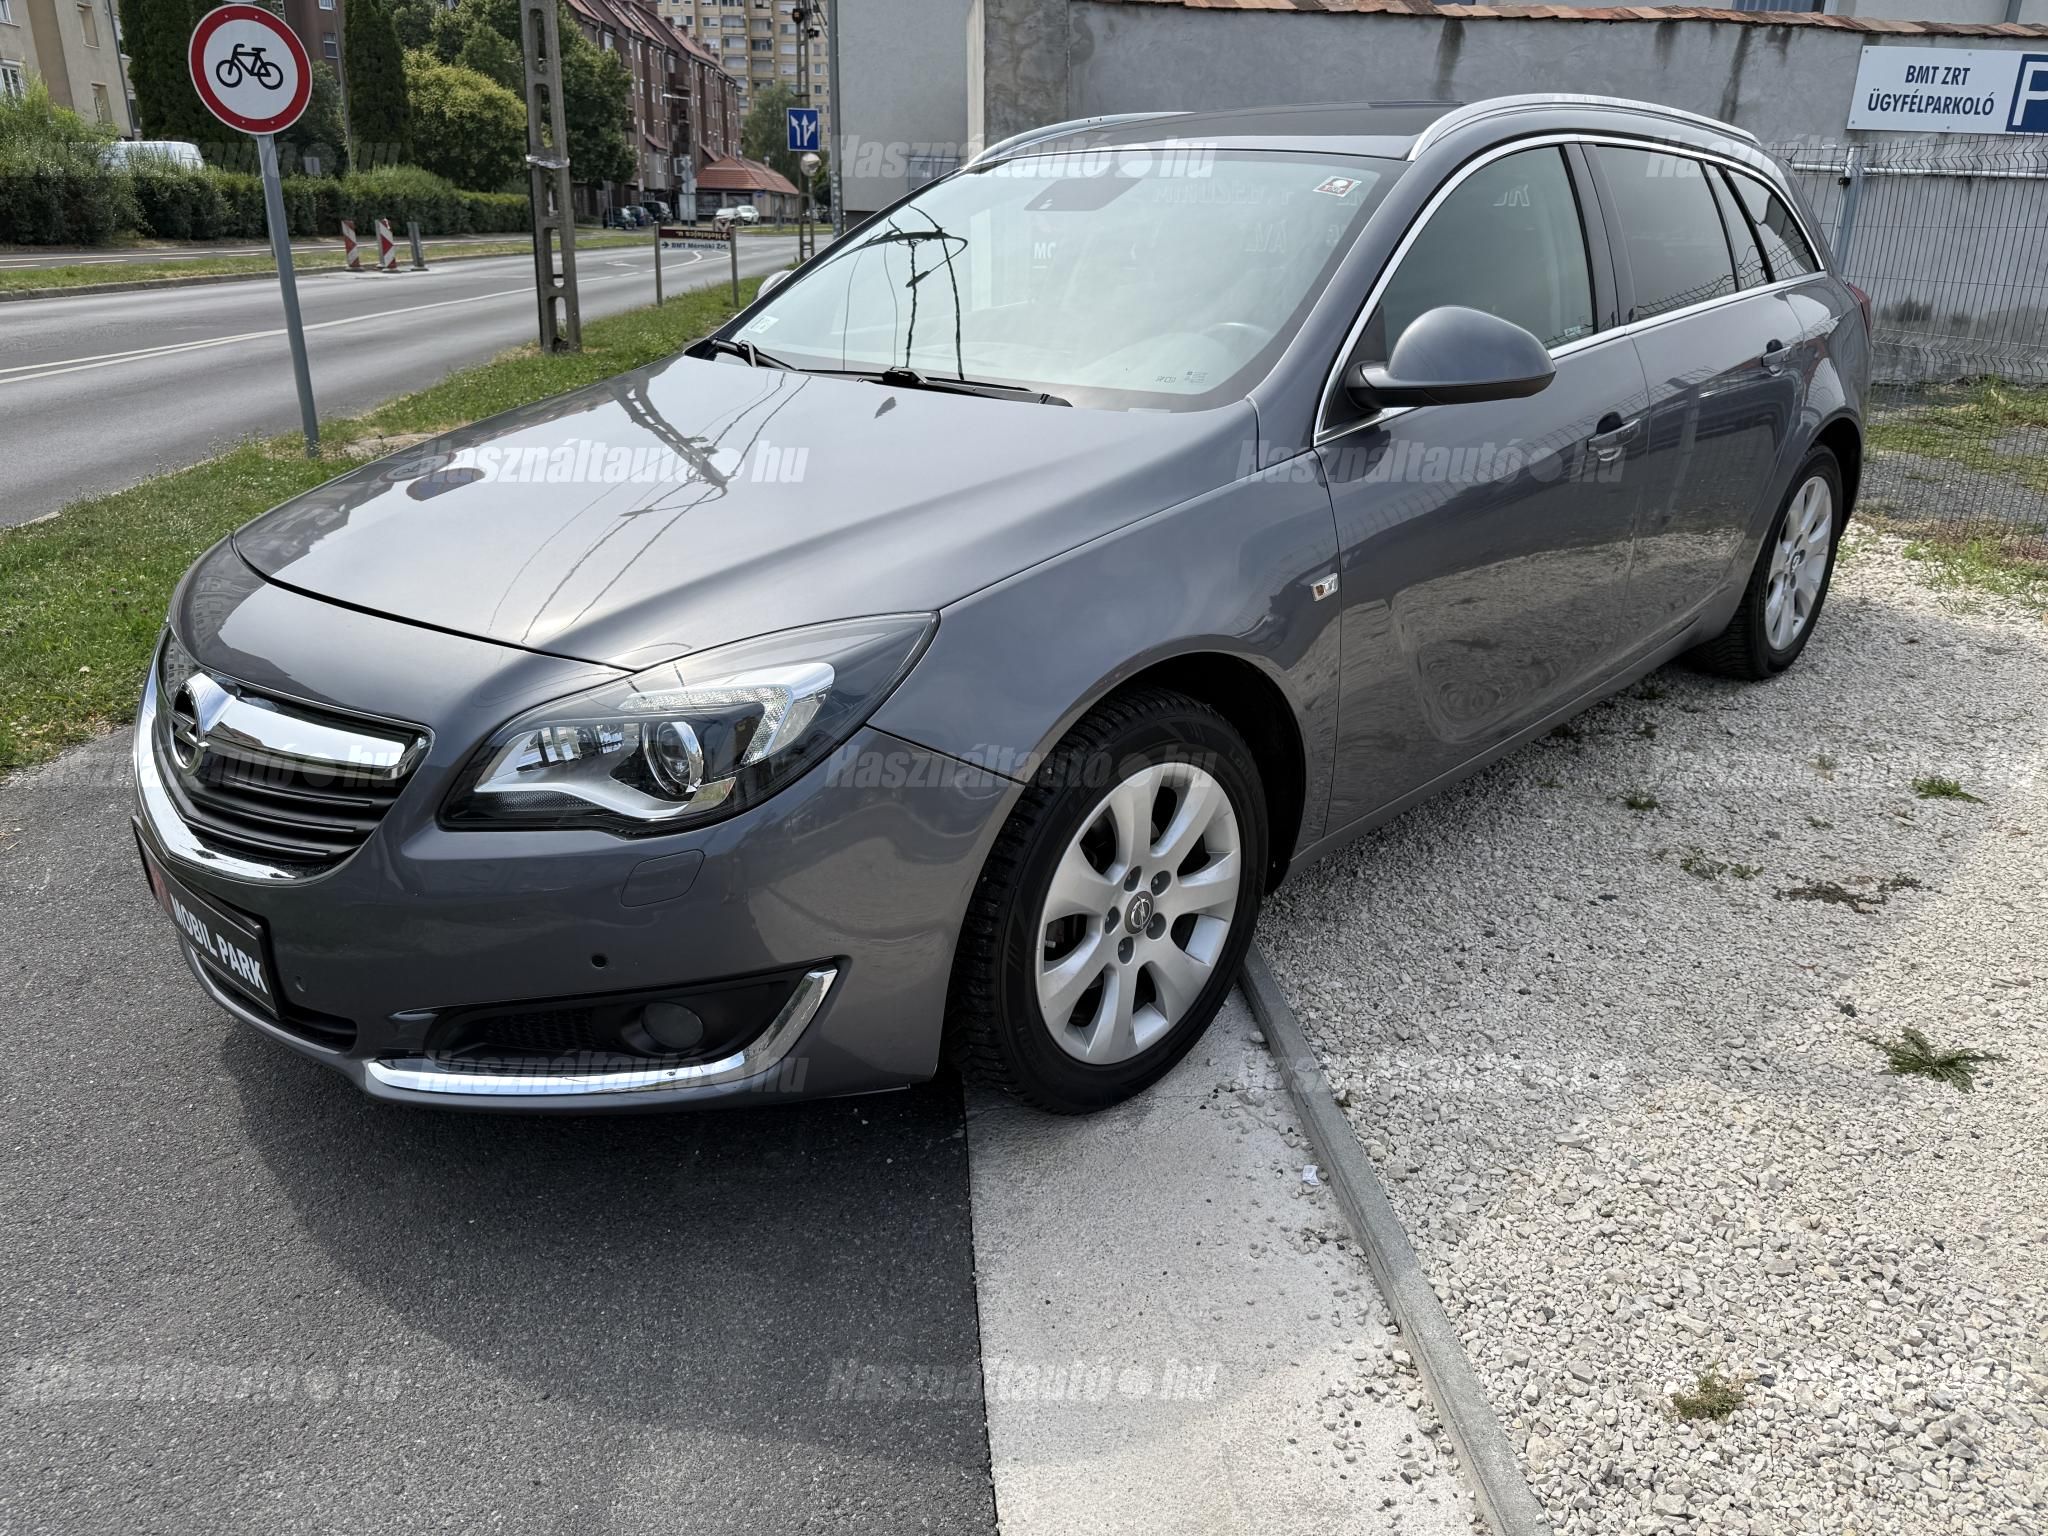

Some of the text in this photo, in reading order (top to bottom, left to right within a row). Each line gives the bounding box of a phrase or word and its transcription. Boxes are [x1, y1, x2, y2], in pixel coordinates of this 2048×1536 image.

[1905, 65, 1971, 86] BMT ZRT
[1867, 88, 1994, 116] ÜGYFÉLPARKOLÓ
[169, 892, 269, 994] MOBIL PARK
